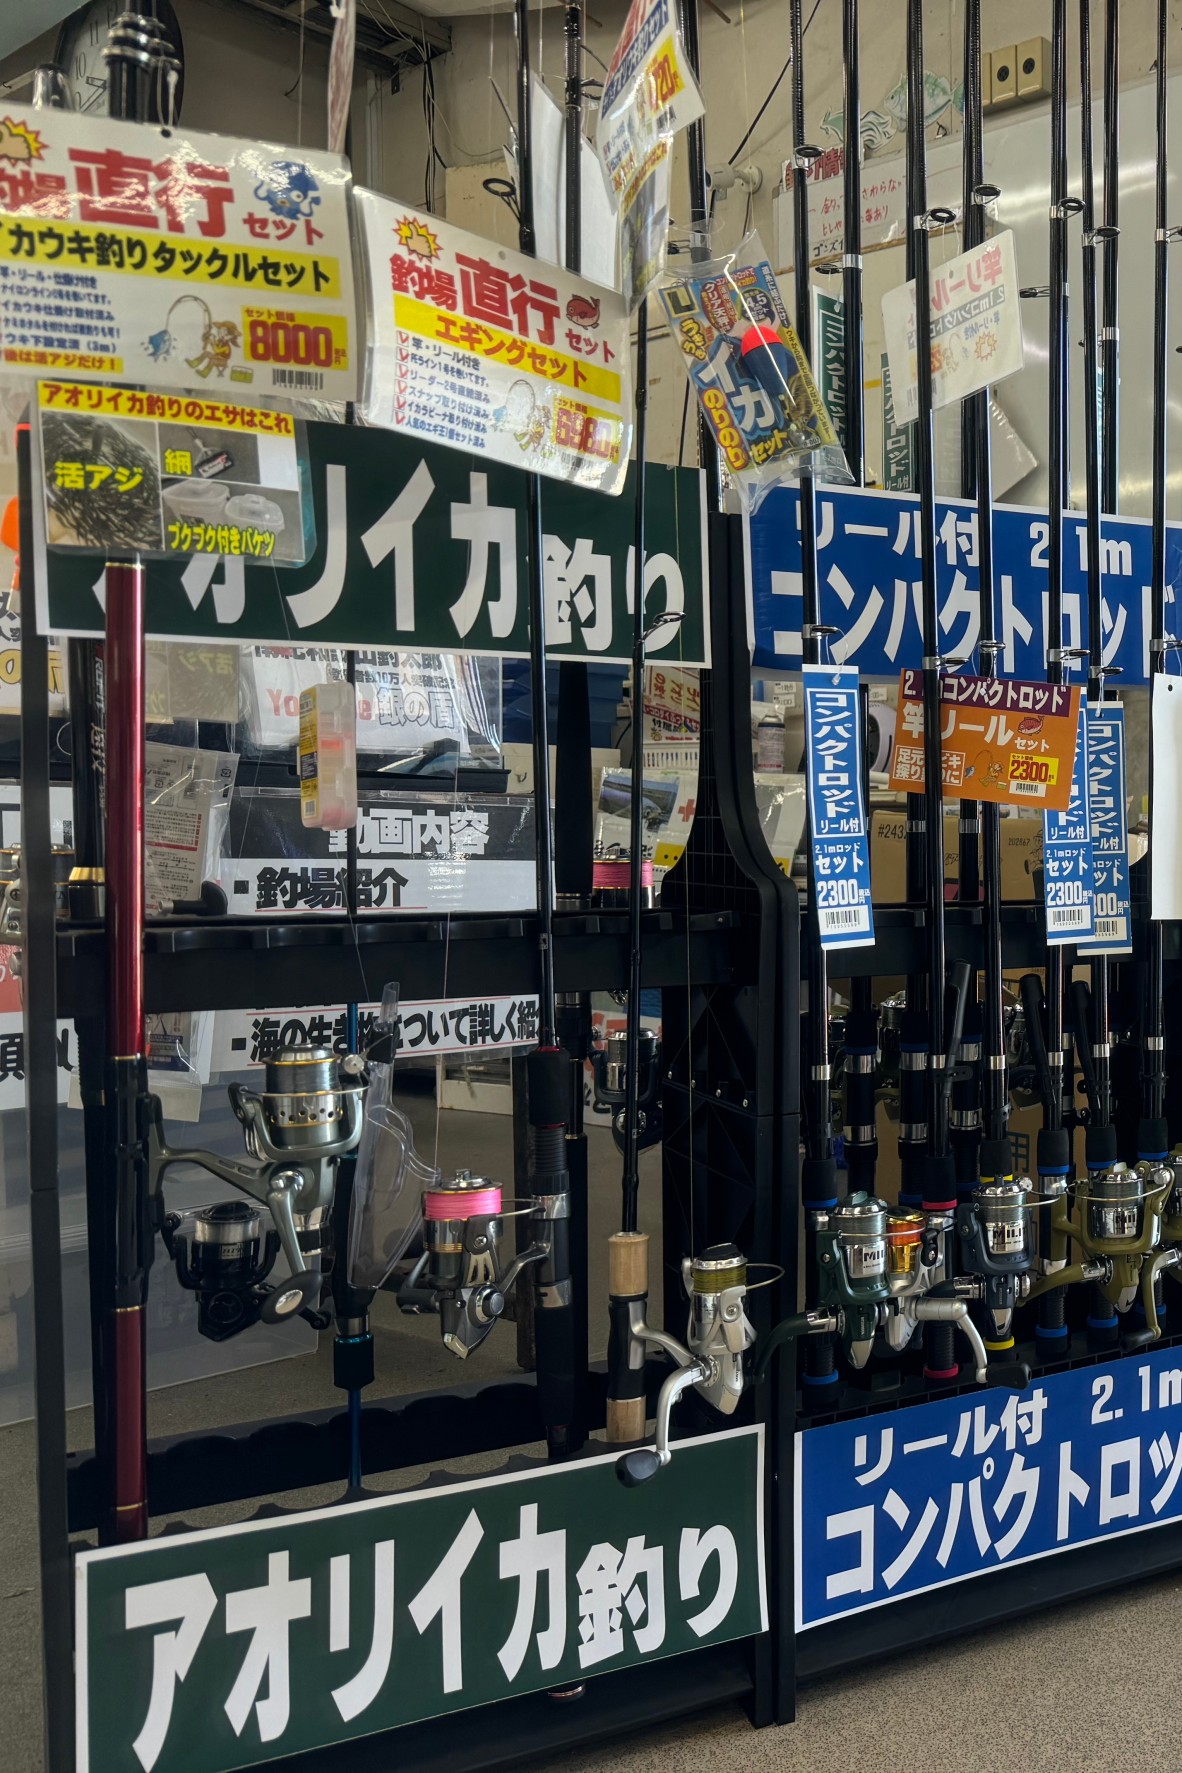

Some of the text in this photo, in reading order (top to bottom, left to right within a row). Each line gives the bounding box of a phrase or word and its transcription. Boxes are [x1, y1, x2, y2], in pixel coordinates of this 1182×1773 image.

[75, 52, 87, 80] 10
[0, 147, 324, 245] 場直行 セット
[0, 222, 330, 292] カウキ釣りタックルセット
[389, 252, 561, 346] 釣場直行
[565, 328, 615, 363] セット
[249, 319, 333, 368] 8000
[435, 315, 587, 388] エギングセット
[42, 382, 292, 434] アオリイカ釣りのエサはこれ
[555, 409, 612, 459] 6980
[703, 390, 748, 470] のりのり
[751, 428, 788, 465] セット
[54, 460, 144, 492] 活アジ
[164, 449, 193, 475] 網
[168, 522, 275, 557] ブクブク付きバケツ
[795, 500, 1133, 577] リール付 21m
[771, 563, 1176, 679] コンパクトロッド
[904, 671, 1067, 712] 2.コンパクトロッド
[814, 692, 853, 818] コンパクトロッド
[897, 748, 962, 769] 足元ビキ
[1015, 737, 1050, 752] セット
[1010, 760, 1049, 783] 2300
[820, 817, 860, 833] リール付
[1050, 826, 1085, 839] リール付
[815, 852, 864, 875] セット
[1046, 857, 1088, 876] セット
[256, 866, 409, 909] 釣場紹介
[817, 879, 858, 906] 2300
[1046, 881, 1082, 906] 2300
[854, 1388, 1048, 1486] リール付
[125, 1503, 738, 1773] アオリイカ釣り
